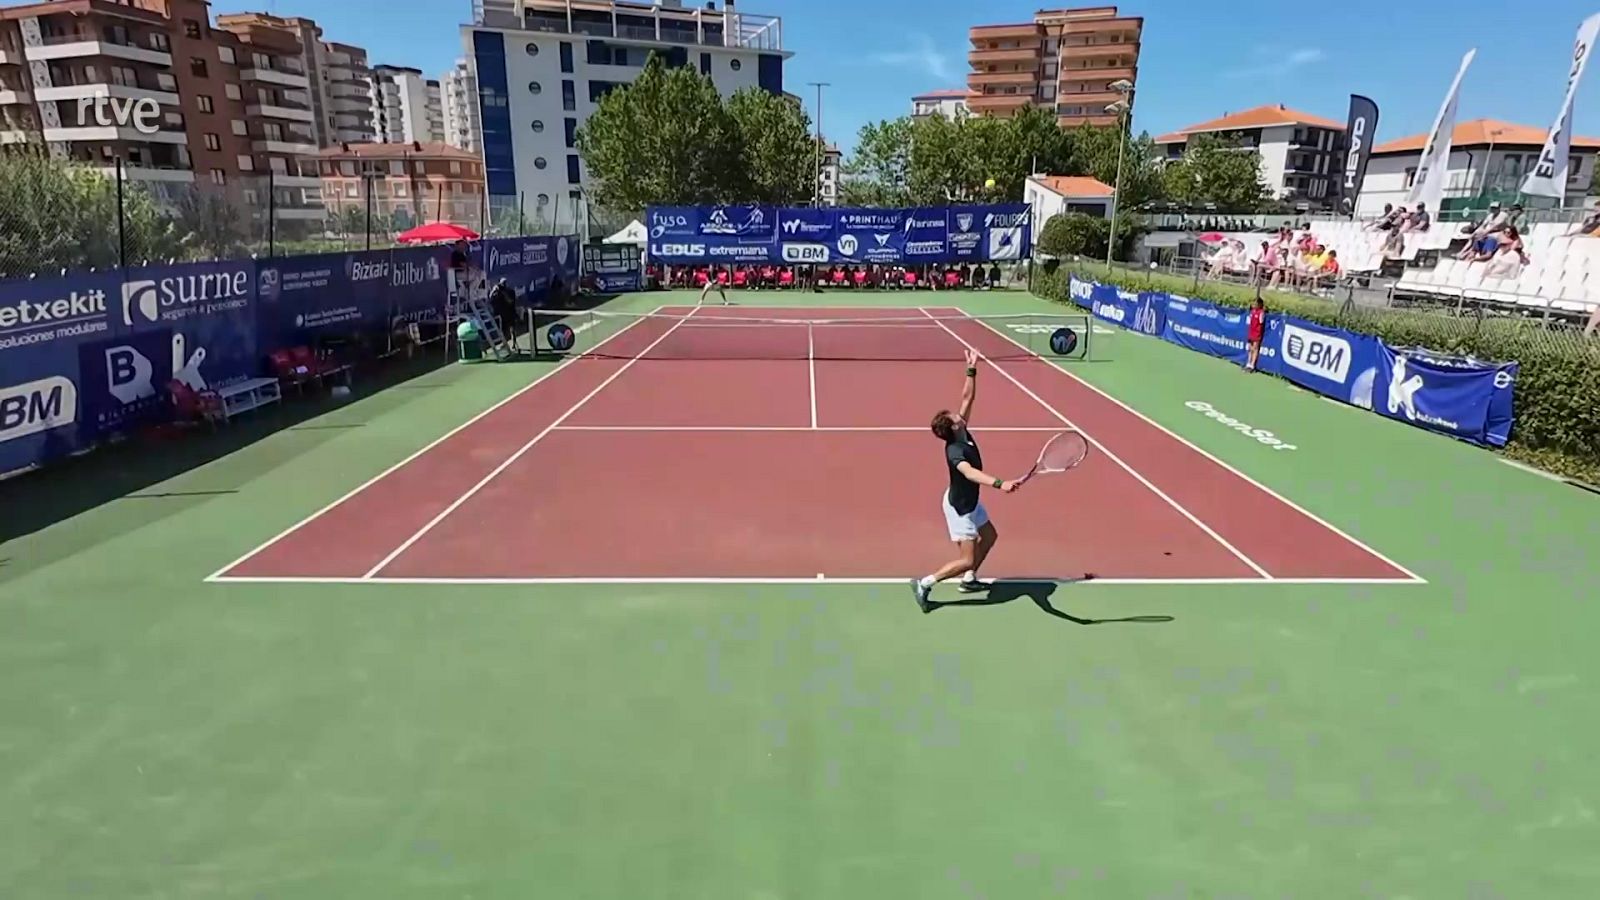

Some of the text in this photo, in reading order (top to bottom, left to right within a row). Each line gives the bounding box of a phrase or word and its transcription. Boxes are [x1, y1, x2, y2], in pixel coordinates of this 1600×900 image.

[1344, 117, 1366, 188] HEAD
[652, 244, 706, 256] LEDUS
[802, 247, 825, 259] BM
[161, 270, 248, 306] surne
[0, 289, 107, 327] etxekit
[1305, 341, 1344, 374] BM
[0, 385, 62, 430] BM
